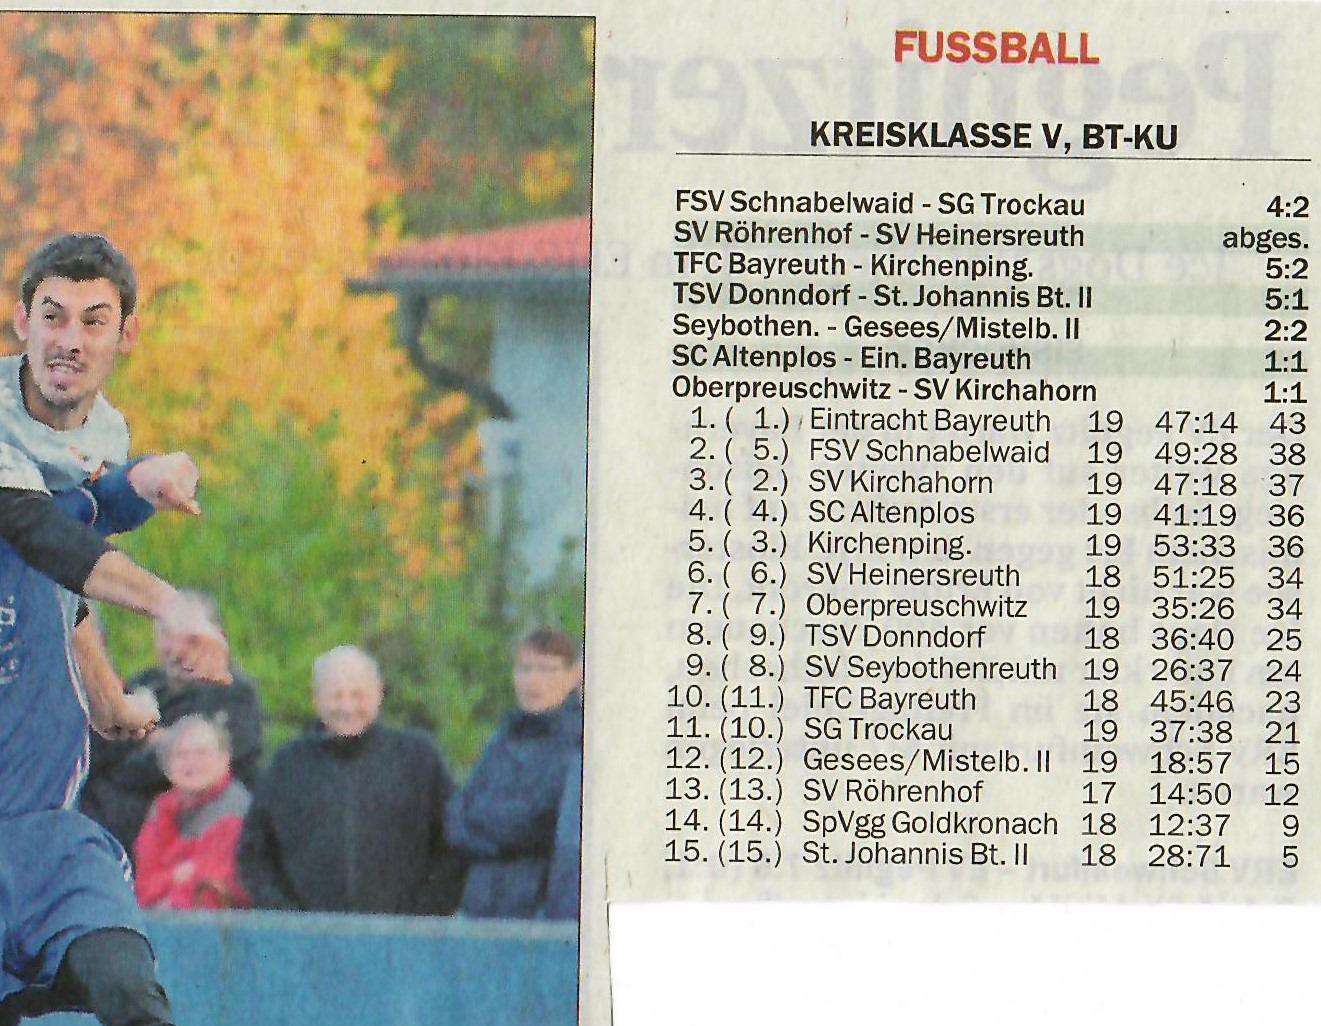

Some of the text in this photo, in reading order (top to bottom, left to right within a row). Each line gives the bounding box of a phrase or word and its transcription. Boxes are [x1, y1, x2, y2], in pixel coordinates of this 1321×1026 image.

[894, 29, 1100, 64] FUSSBALL
[810, 120, 1178, 154] KREISKLASSE V, BT-KU
[676, 189, 1310, 218] FSV Schnabelwaid SG Trockau 4:2
[674, 220, 1309, 254] SV Röhrenhof SV Heinersreuth abges.
[673, 251, 1309, 282] TFC Bayreuth Kirchenping. 5:2
[672, 281, 1309, 311] TSV Donndorf St. Johannis Bt. II 5:1
[672, 312, 1308, 343] Seybothen. Gesees/Mistelb. II 2:2
[671, 343, 1308, 375] SC Altenplos Ein. Bayreuth 1:1
[672, 374, 1308, 404] Oberpreuschwitz SV Kirchahorn 1:1
[811, 406, 1306, 437] Eintracht Bayreuth 19 47:14 43
[810, 438, 1306, 466] FSV Schnabelwaid 19 49:28 38
[808, 468, 1305, 497] SV Kirchahorn 19 47:18 37
[808, 499, 1305, 529] SC Altenplos 19 41:19 36
[808, 530, 1304, 561] Kirchenping. 53:33 36
[807, 561, 1304, 590] SV Heinersreuth 51:25 34
[806, 592, 1303, 622] Oberpreuschwitz 35:26 34
[804, 623, 1302, 652] TSV Donndorf 36:40 25
[805, 654, 1302, 684] SV Seybothenreuth 26:37 24
[803, 685, 1301, 716] TFC Bayreuth 45:46 23
[804, 716, 1301, 745] SG Trockau 37:38 21
[803, 747, 1300, 777] Gesees/Mistelb. II 18:57 15
[803, 778, 1299, 806] SV Röhrenhof 14:50 12
[802, 809, 1300, 839] SpVgg Goldkronach 12:37 9
[802, 840, 1299, 869] St. Johannis Bt. II 28:71 5
